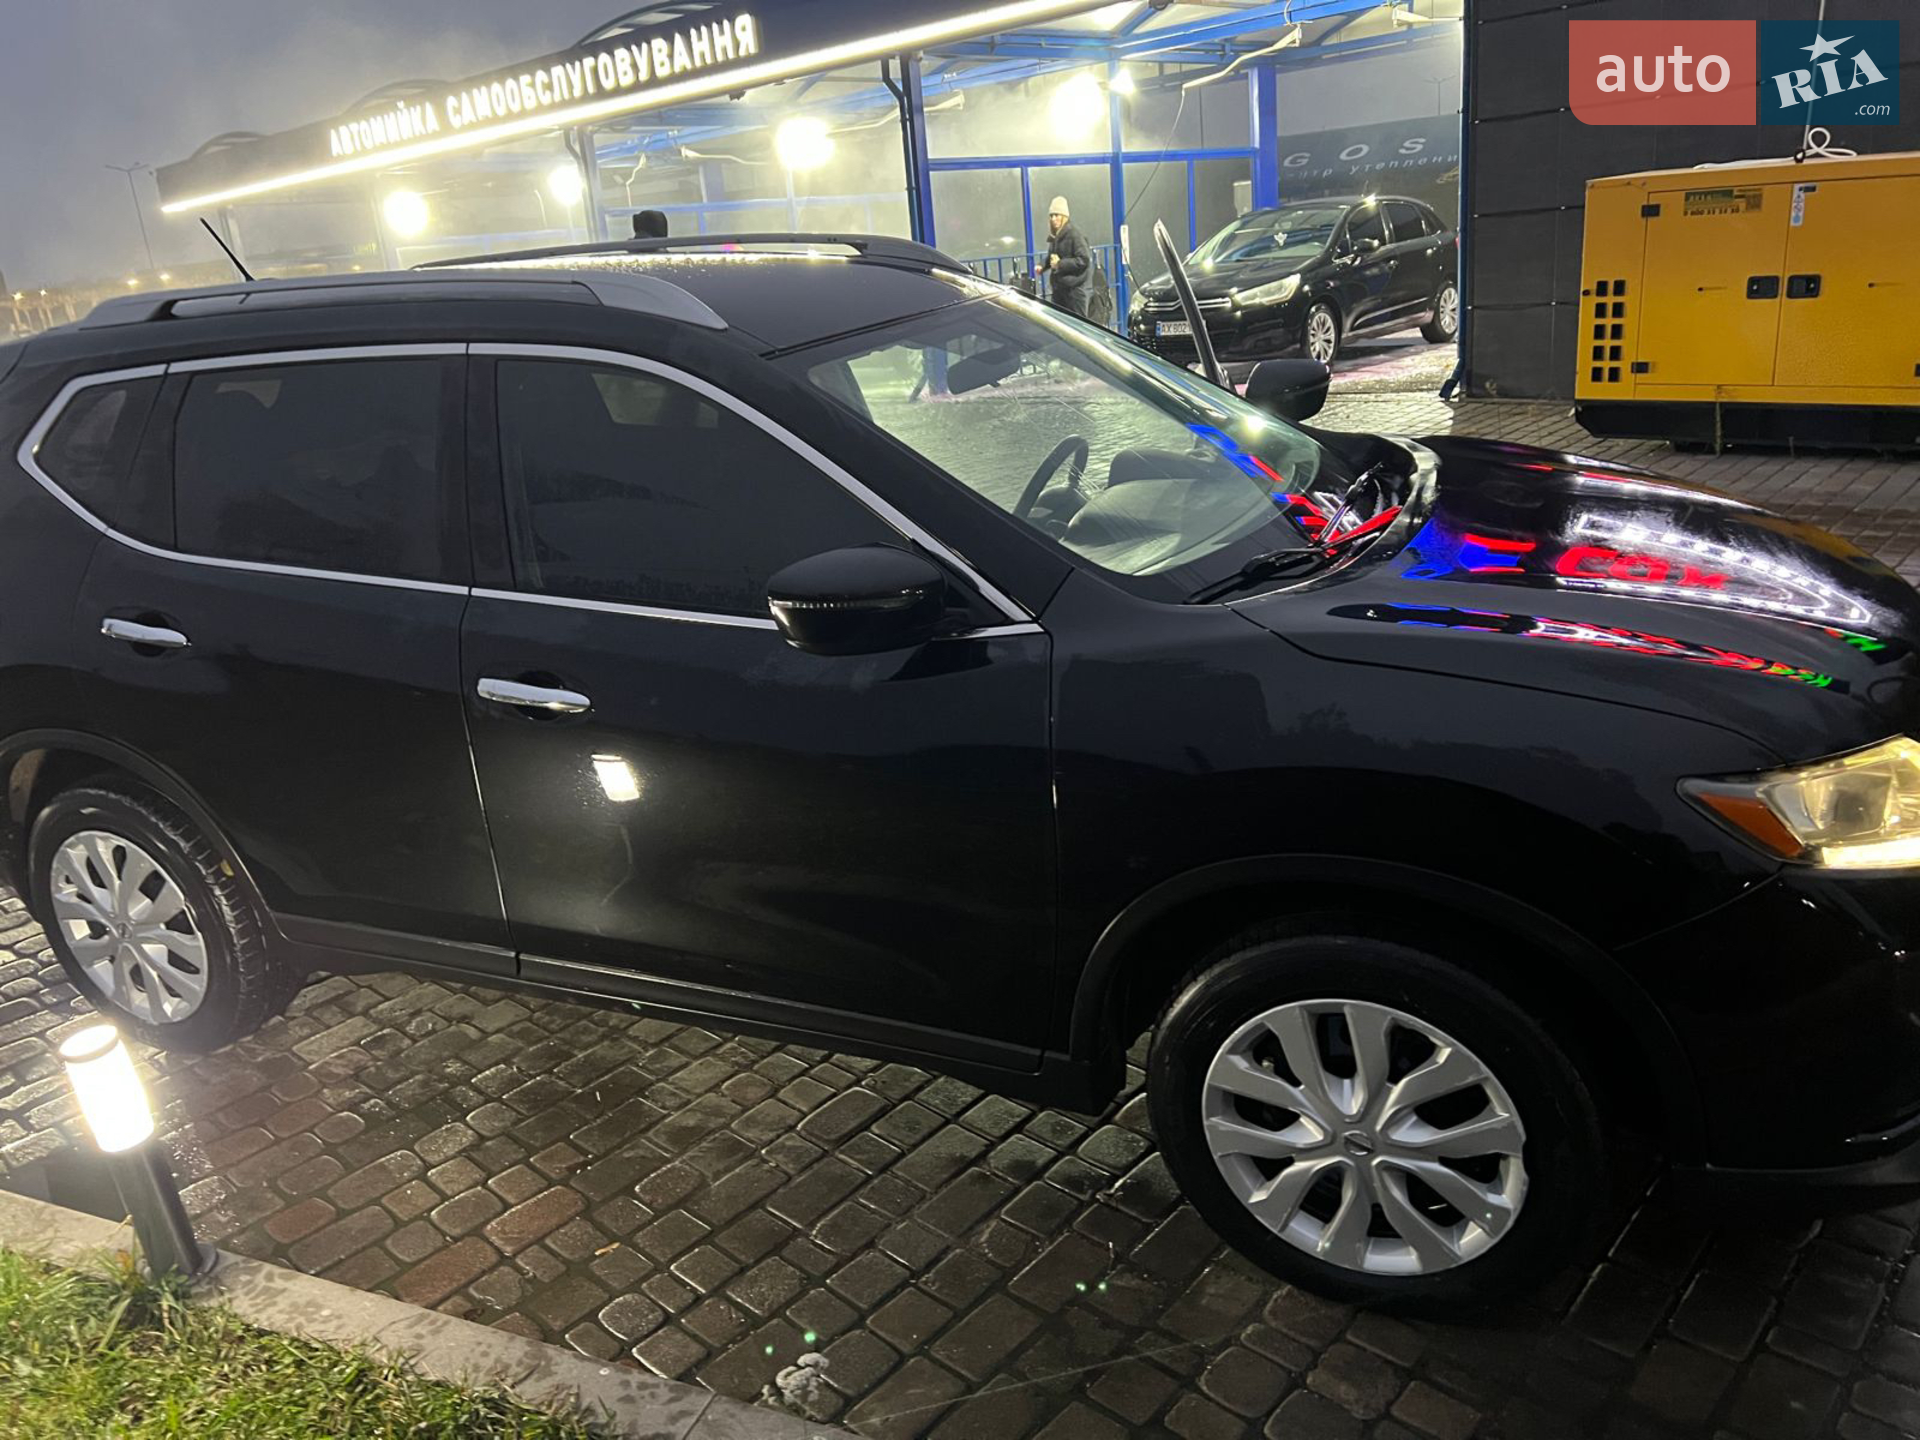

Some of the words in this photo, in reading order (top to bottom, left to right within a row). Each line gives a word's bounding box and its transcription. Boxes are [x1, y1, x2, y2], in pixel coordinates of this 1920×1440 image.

[329, 101, 440, 158] АВТОМИЙКА
[446, 13, 759, 128] САМООБСЛУГОВУВАННЯ
[1349, 153, 1458, 175] утеплени
